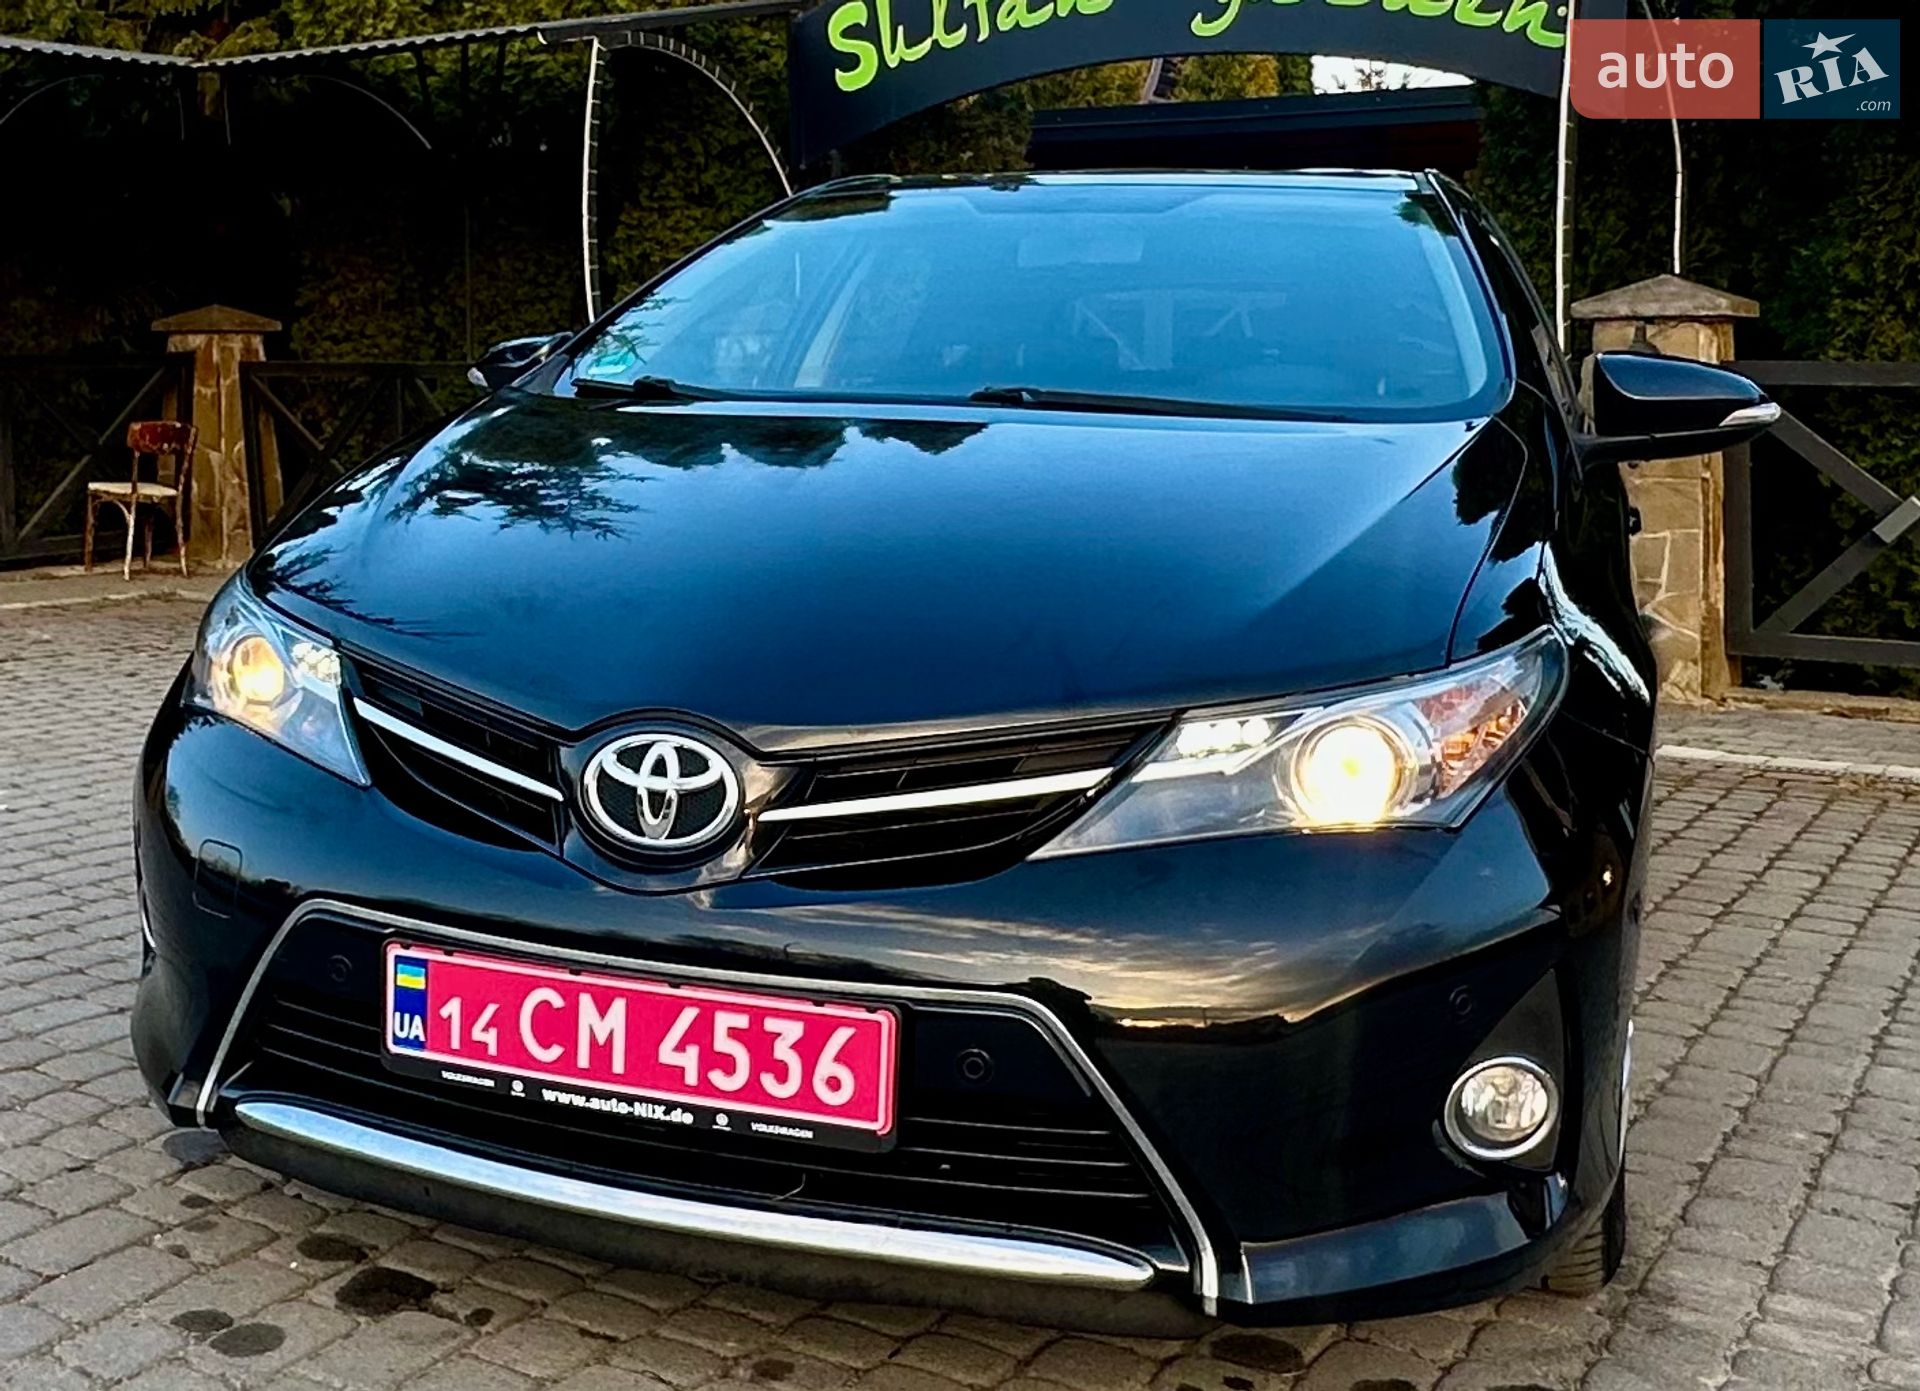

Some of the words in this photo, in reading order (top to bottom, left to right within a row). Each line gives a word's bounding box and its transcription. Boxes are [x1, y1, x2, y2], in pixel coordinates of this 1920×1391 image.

[394, 1011, 426, 1042] UA
[439, 996, 500, 1057] 14
[519, 986, 627, 1075] CM
[657, 1005, 856, 1107] 4536
